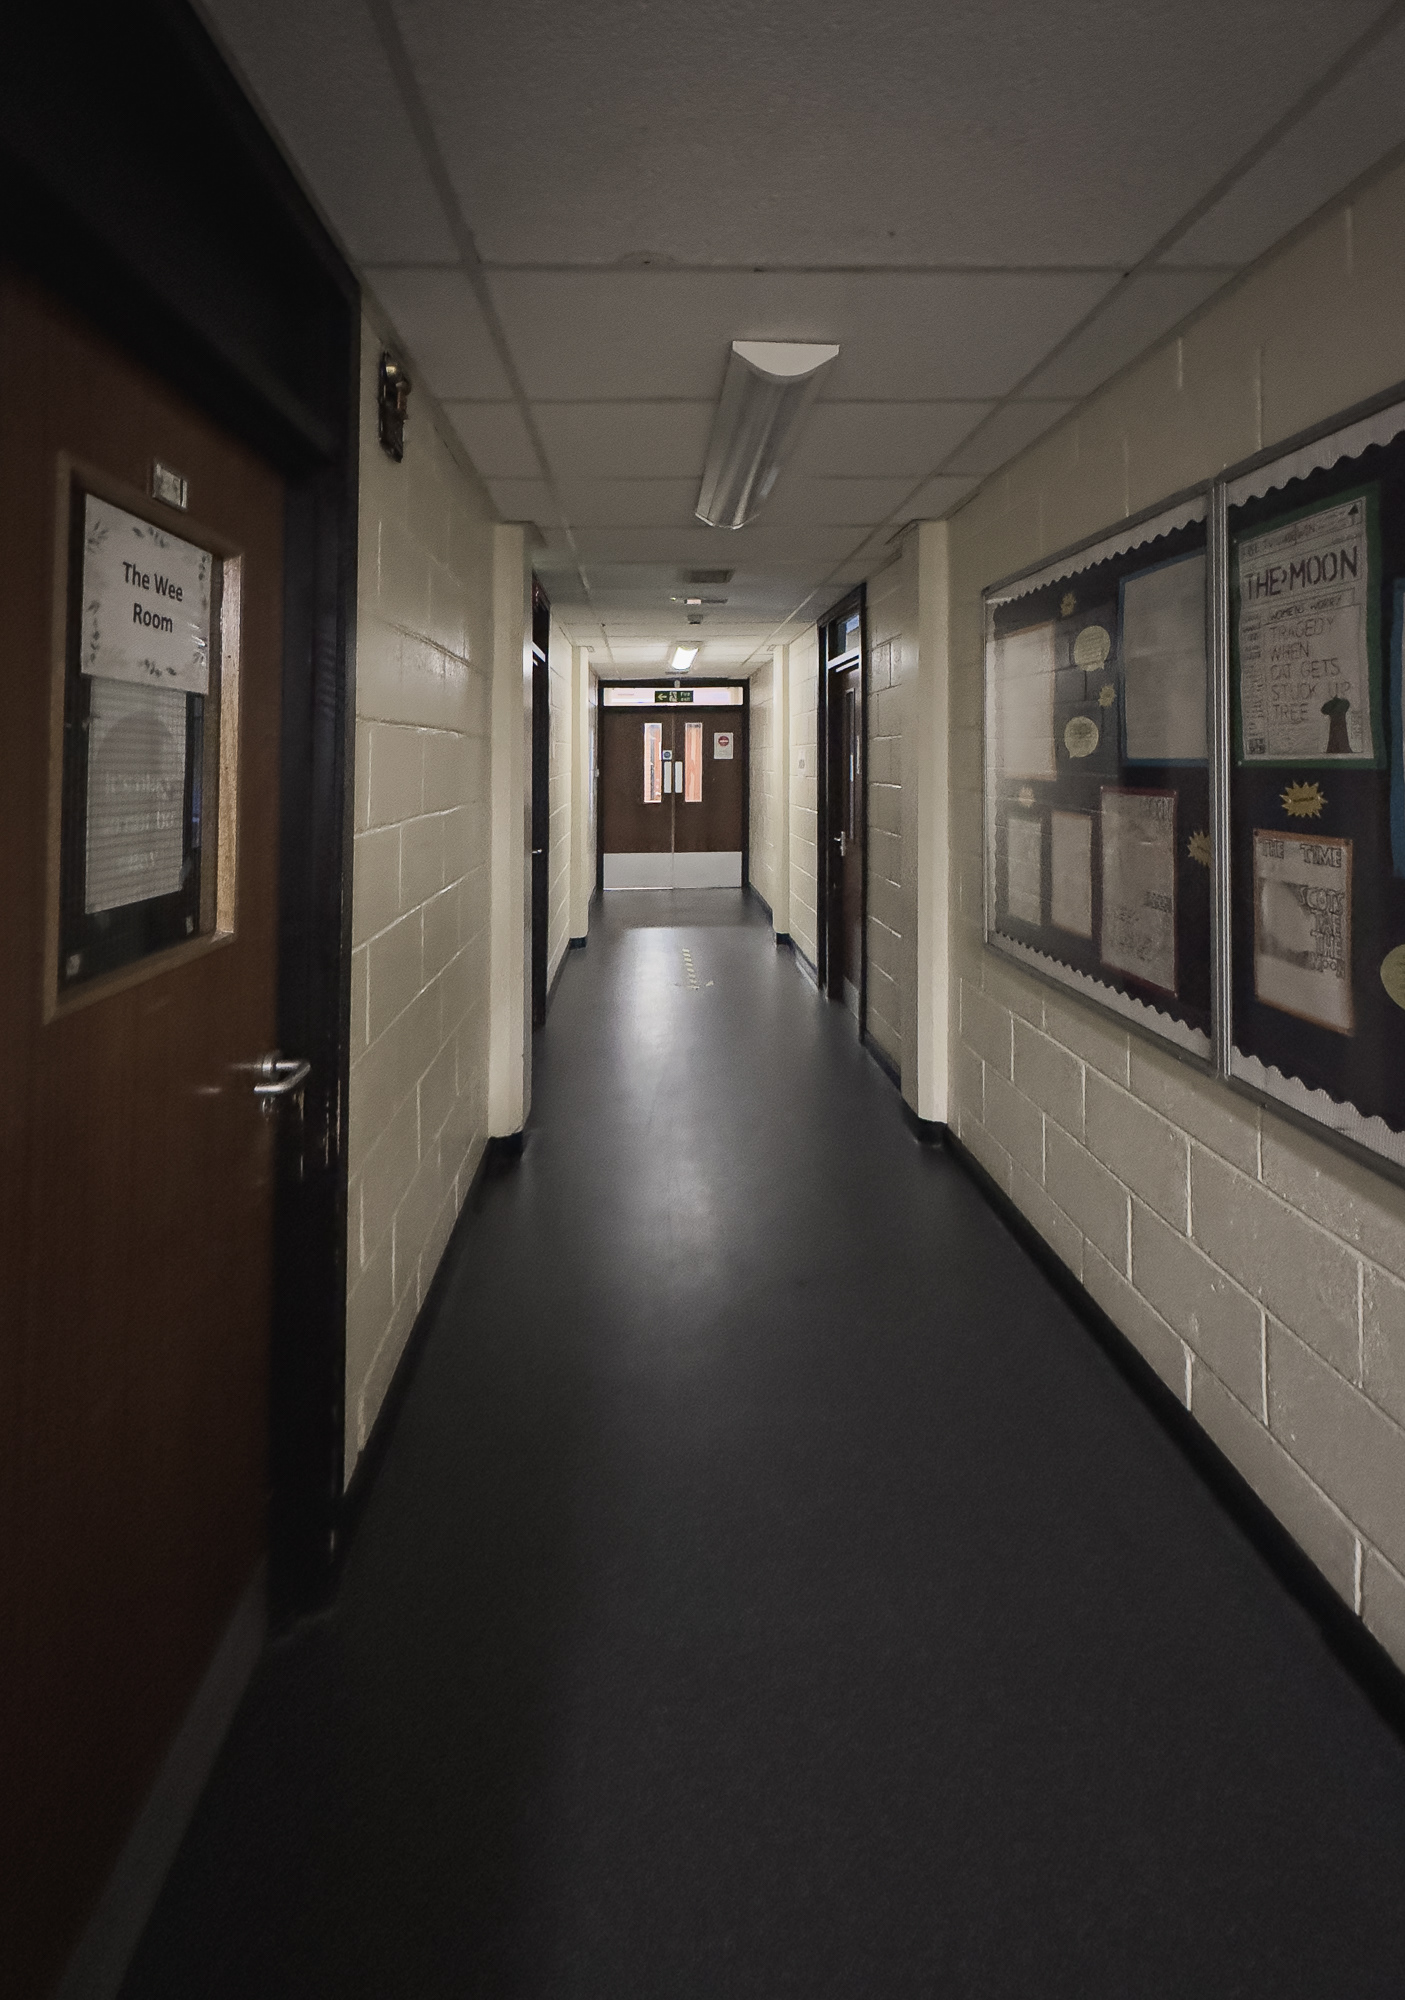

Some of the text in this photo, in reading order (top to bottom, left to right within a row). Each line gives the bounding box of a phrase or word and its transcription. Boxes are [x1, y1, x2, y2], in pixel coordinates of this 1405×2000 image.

[122, 560, 183, 602] The Wee
[1244, 546, 1358, 600] THE MOON
[133, 602, 173, 634] Room
[1269, 616, 1334, 638] TRAGEDY
[1270, 640, 1309, 662] WHEN
[1270, 657, 1341, 680] CAT GETS
[1270, 681, 1318, 701] STUCK
[1272, 703, 1309, 724] TREE
[1259, 838, 1342, 868] THE TIME
